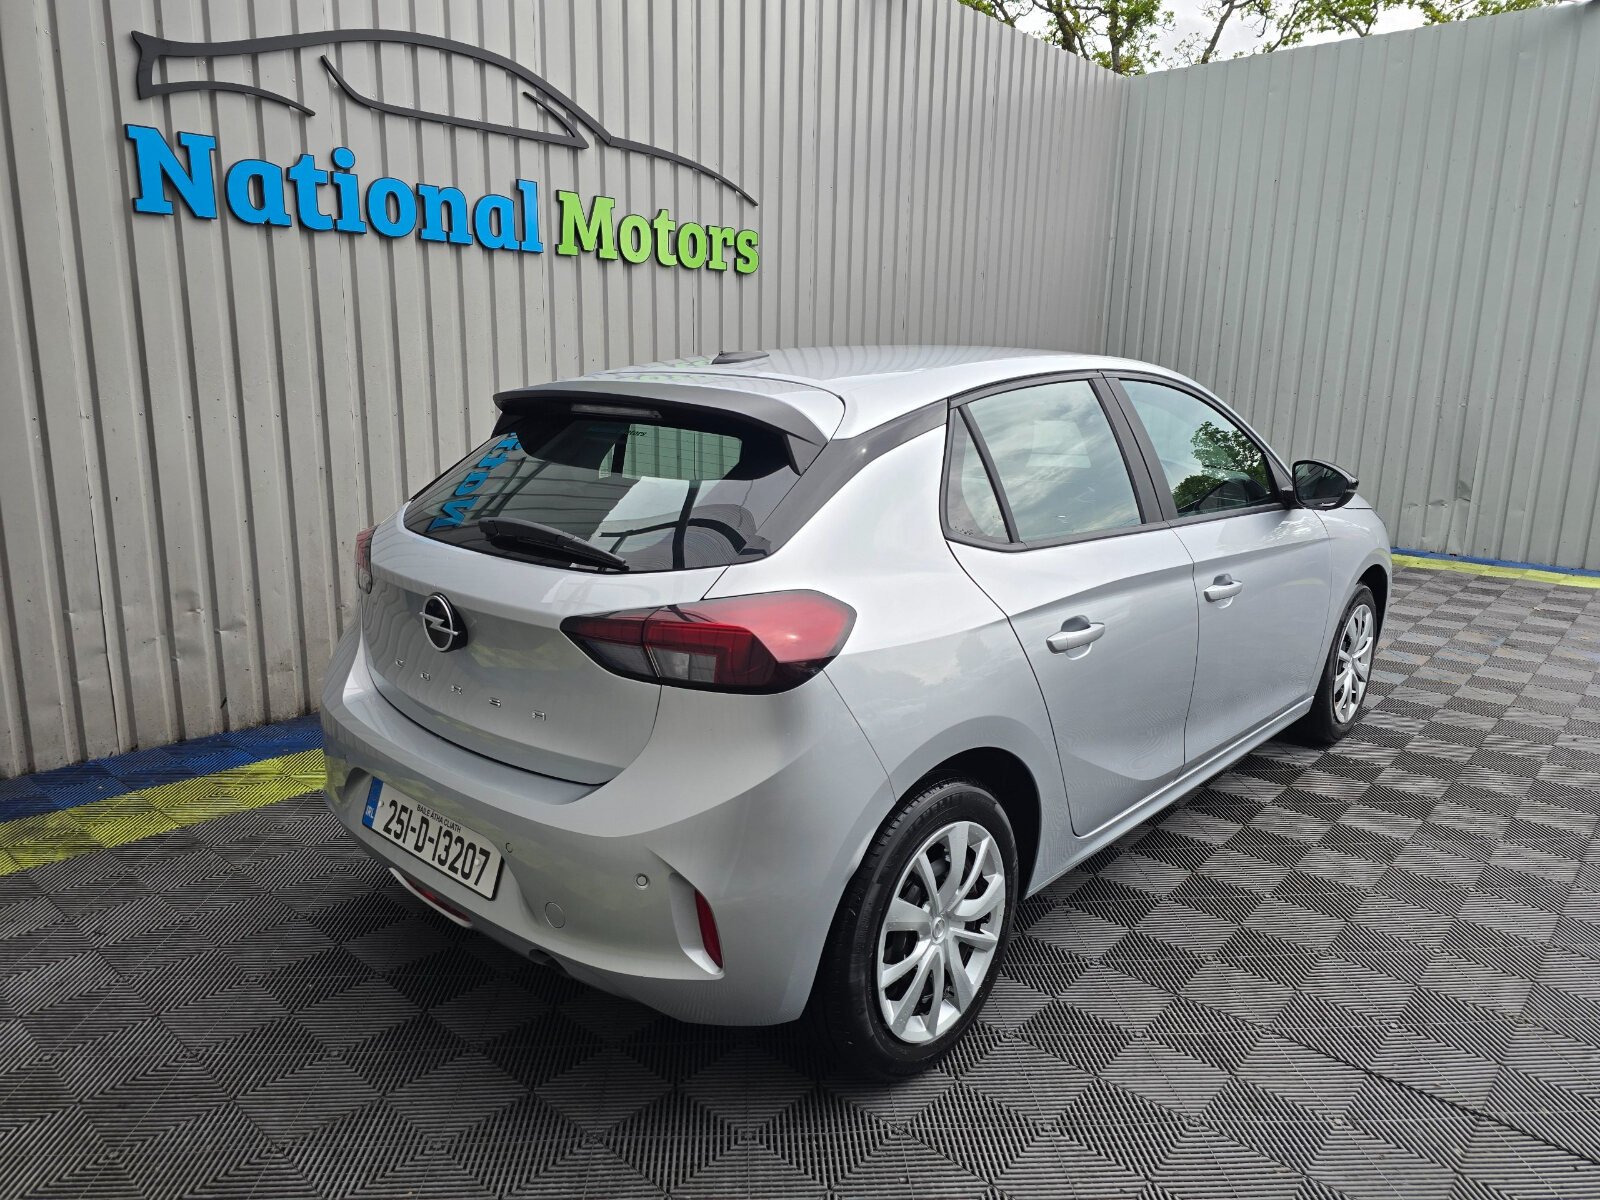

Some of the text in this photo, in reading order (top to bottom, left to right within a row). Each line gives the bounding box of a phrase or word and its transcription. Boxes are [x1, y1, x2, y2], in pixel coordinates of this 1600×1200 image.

[125, 123, 759, 274] National Motors
[382, 799, 491, 887] 251-D-13207
[416, 804, 431, 817] BAILE
